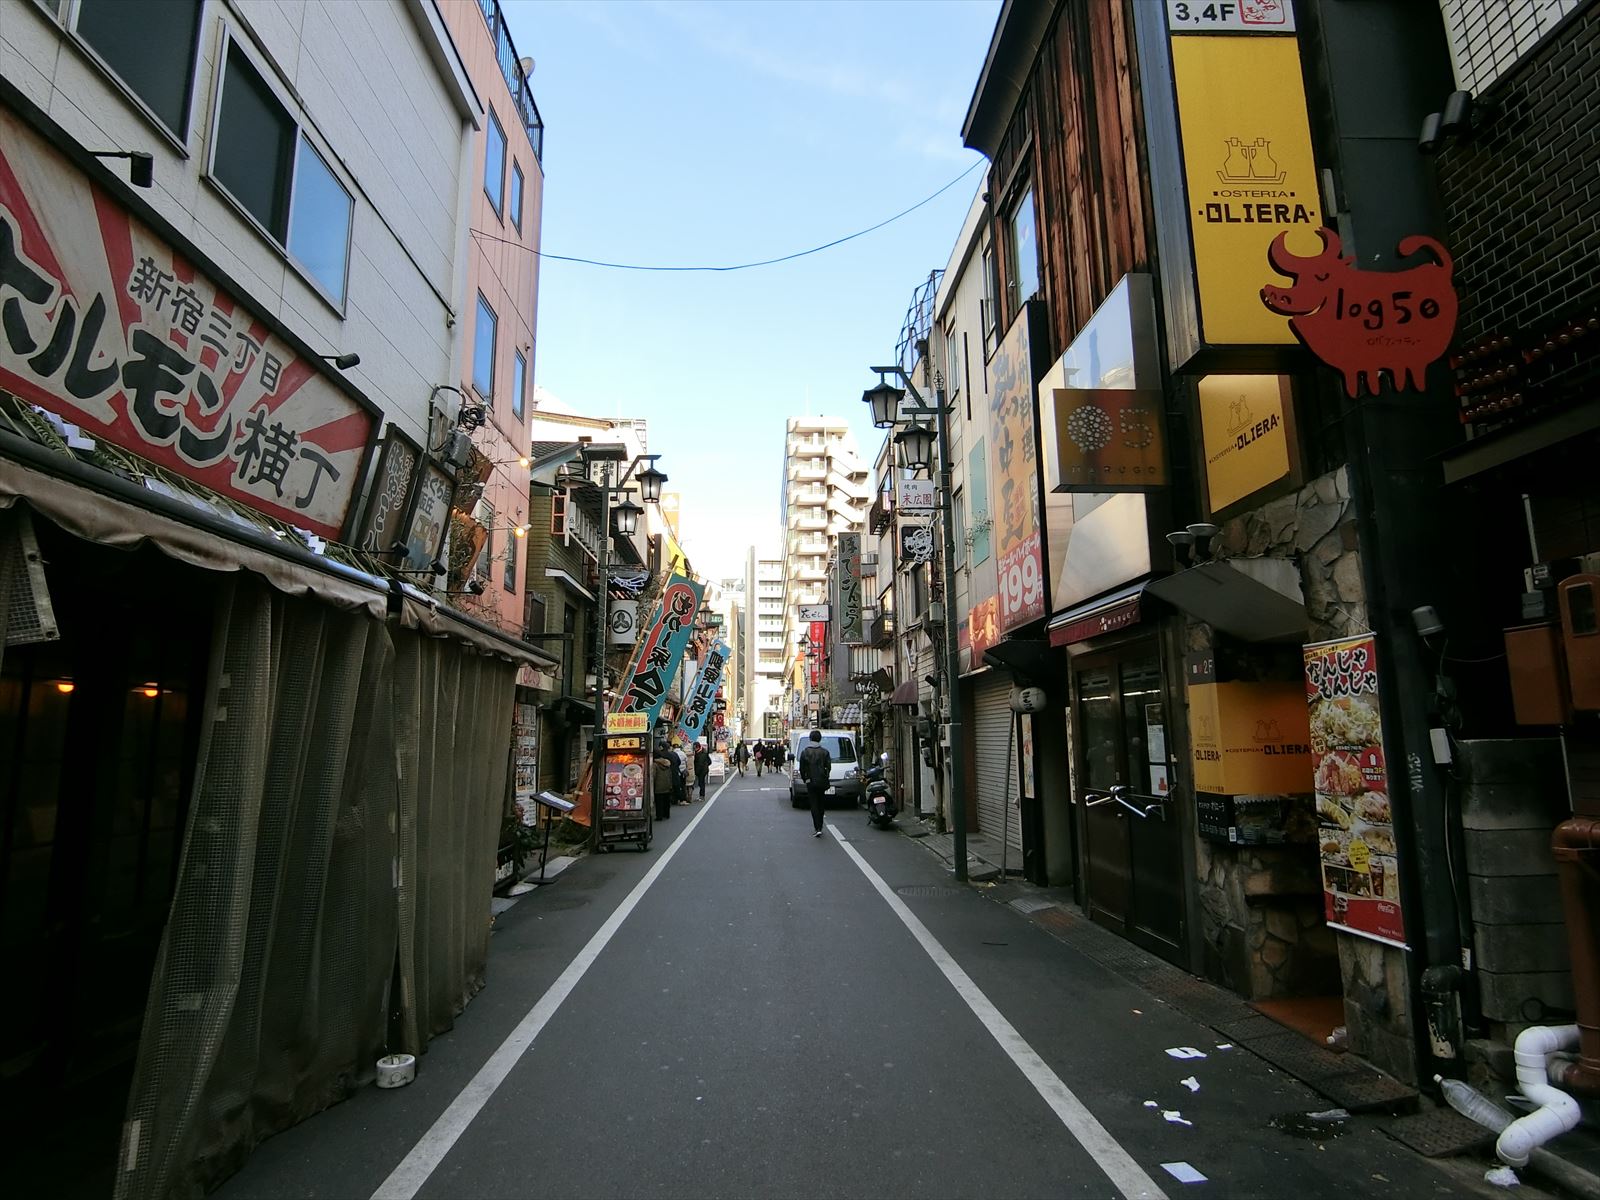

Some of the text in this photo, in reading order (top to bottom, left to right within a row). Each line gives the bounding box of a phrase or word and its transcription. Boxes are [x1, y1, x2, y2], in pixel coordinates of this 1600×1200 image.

[1174, 3, 1235, 22] 3,4F
[1220, 189, 1289, 198] OSTERIA
[1206, 203, 1311, 223] OLIERA
[130, 256, 283, 393] 新宿三丁目
[1237, 413, 1278, 451] OLIERA
[902, 493, 931, 506] 末広園
[1203, 659, 1213, 675] 2F
[1306, 648, 1367, 684] なんじゃ
[1322, 671, 1377, 700] もんじゃ
[1195, 749, 1220, 762] OLIERA
[1263, 744, 1311, 755] OLIERA
